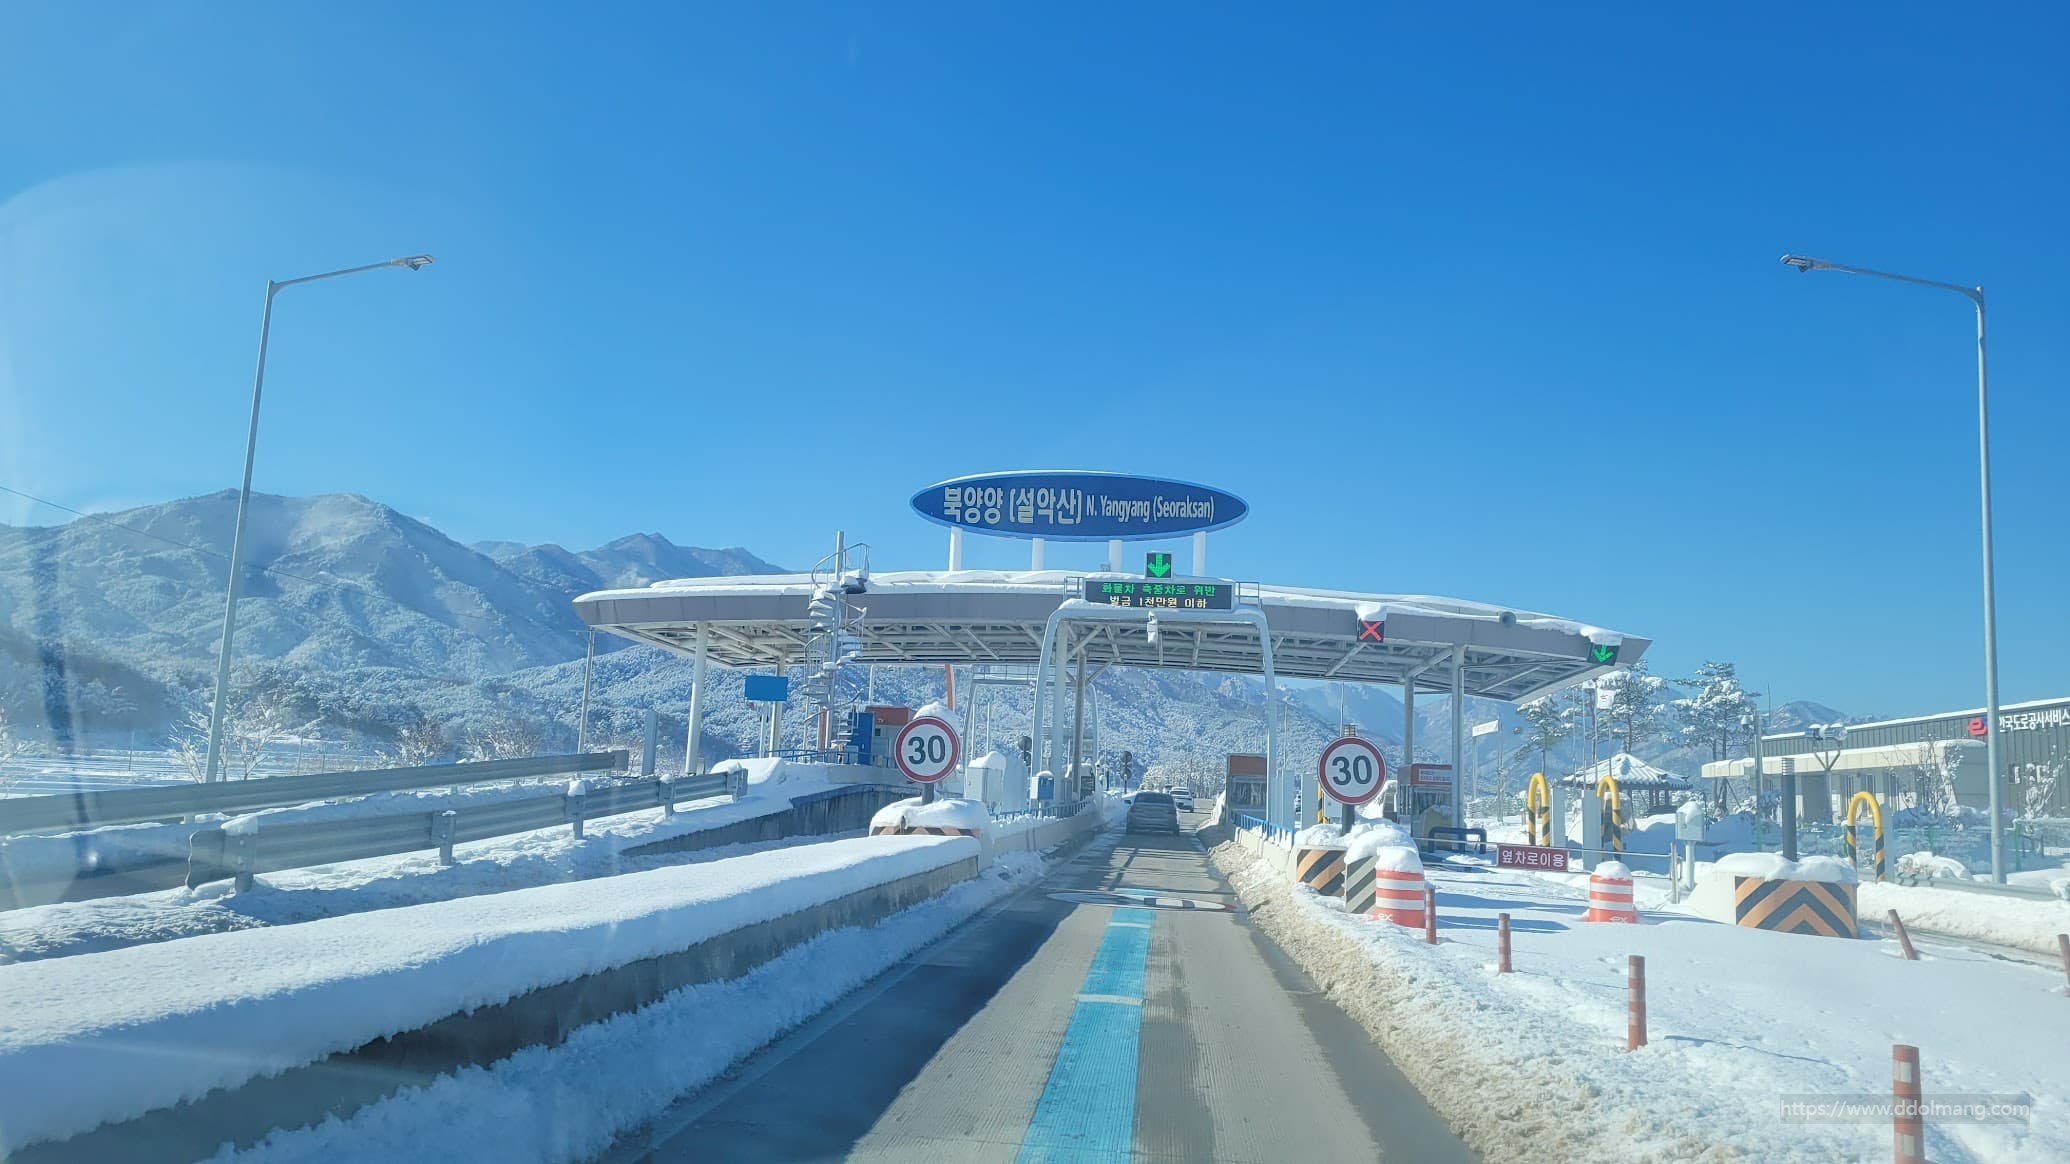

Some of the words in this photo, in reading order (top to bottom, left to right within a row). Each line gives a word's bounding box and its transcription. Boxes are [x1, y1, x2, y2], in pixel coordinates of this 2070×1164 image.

[944, 487, 1003, 524] 북양양
[1086, 495, 1097, 516] N.
[1100, 495, 1150, 522] Yangyang
[1153, 495, 1214, 522] (Seoraksan)
[1140, 597, 1177, 608] 1천만원
[1185, 598, 1207, 608] 이하
[1194, 585, 1216, 596] 위반
[908, 735, 945, 765] 30
[1332, 755, 1372, 785] 30
[1502, 850, 1564, 868] 옆차로이용
